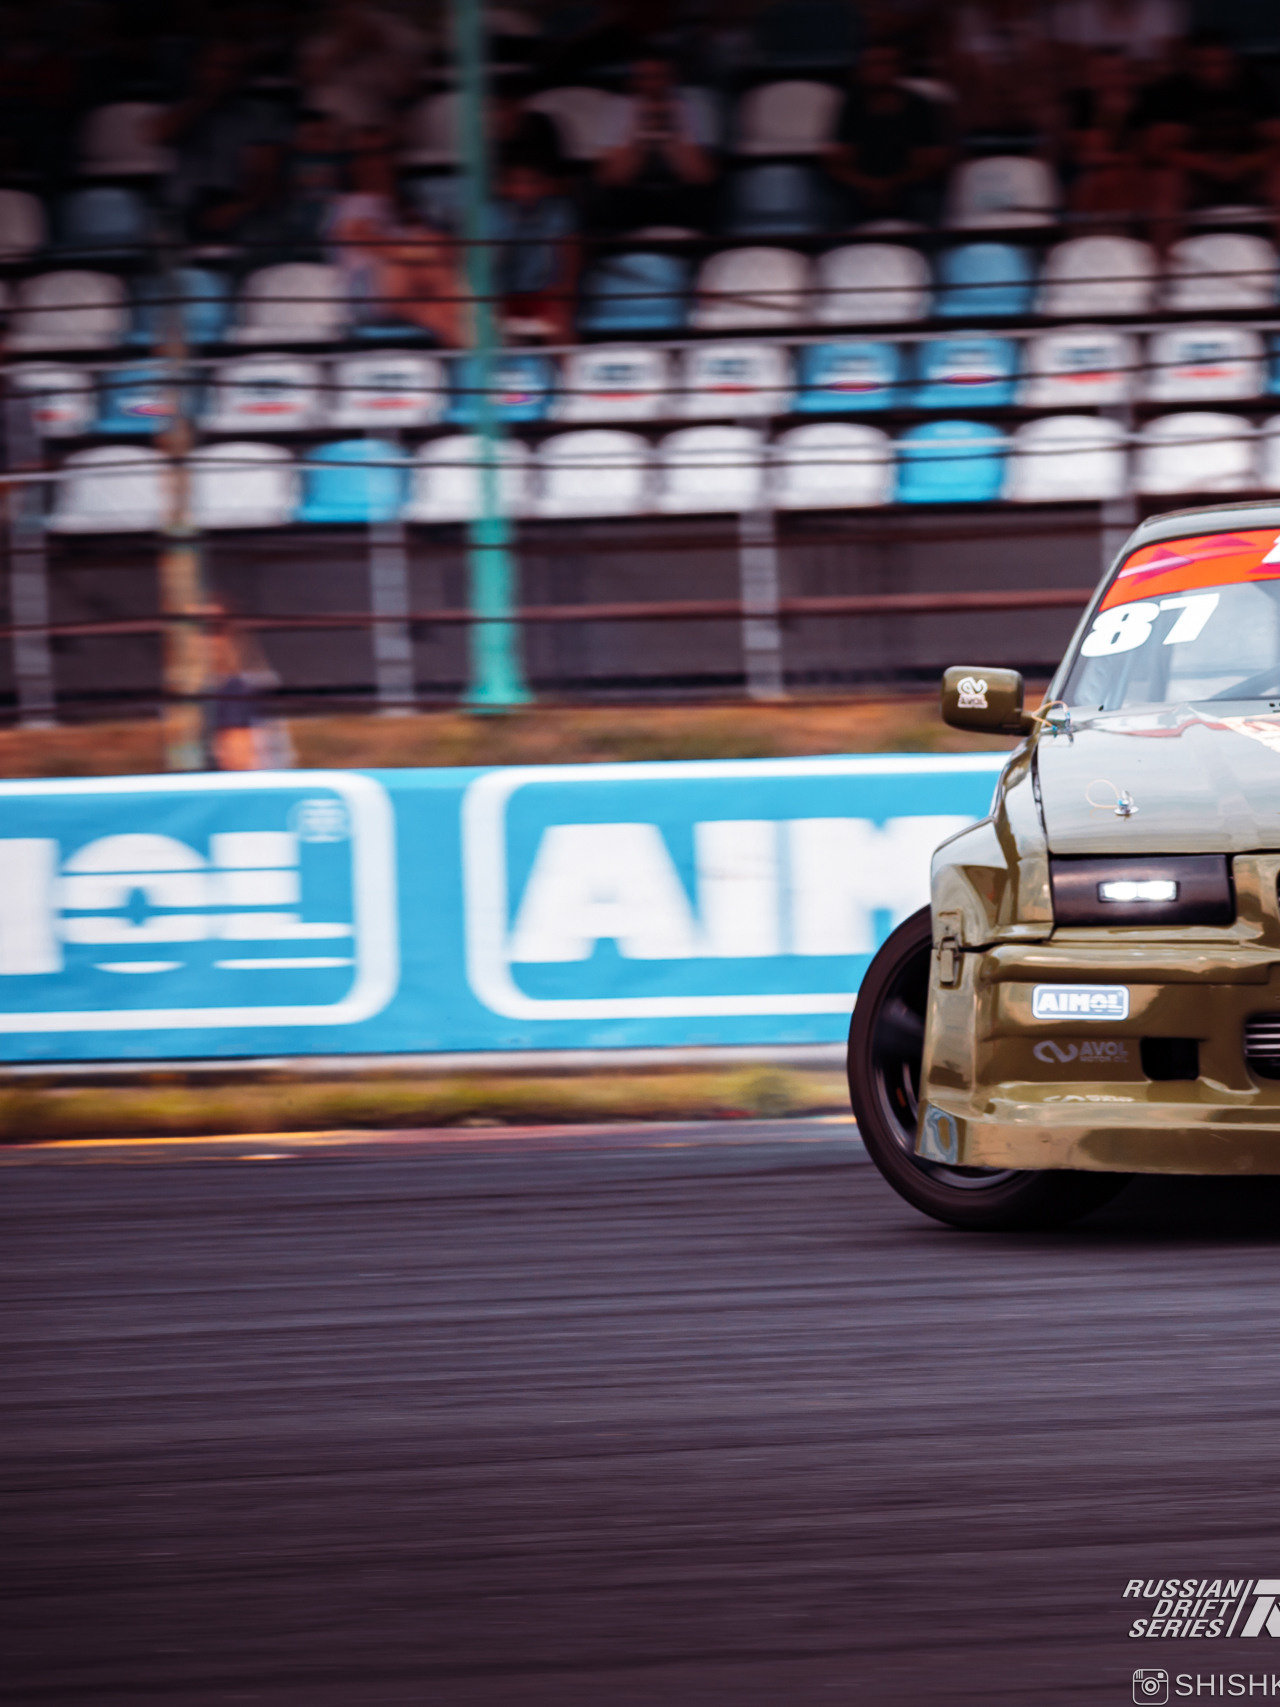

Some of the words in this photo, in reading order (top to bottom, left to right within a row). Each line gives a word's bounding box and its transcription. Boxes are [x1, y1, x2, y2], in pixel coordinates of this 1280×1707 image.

[1080, 593, 1220, 657] 87
[1037, 993, 1123, 1013] AIMOL
[1080, 1041, 1128, 1056] AVOL
